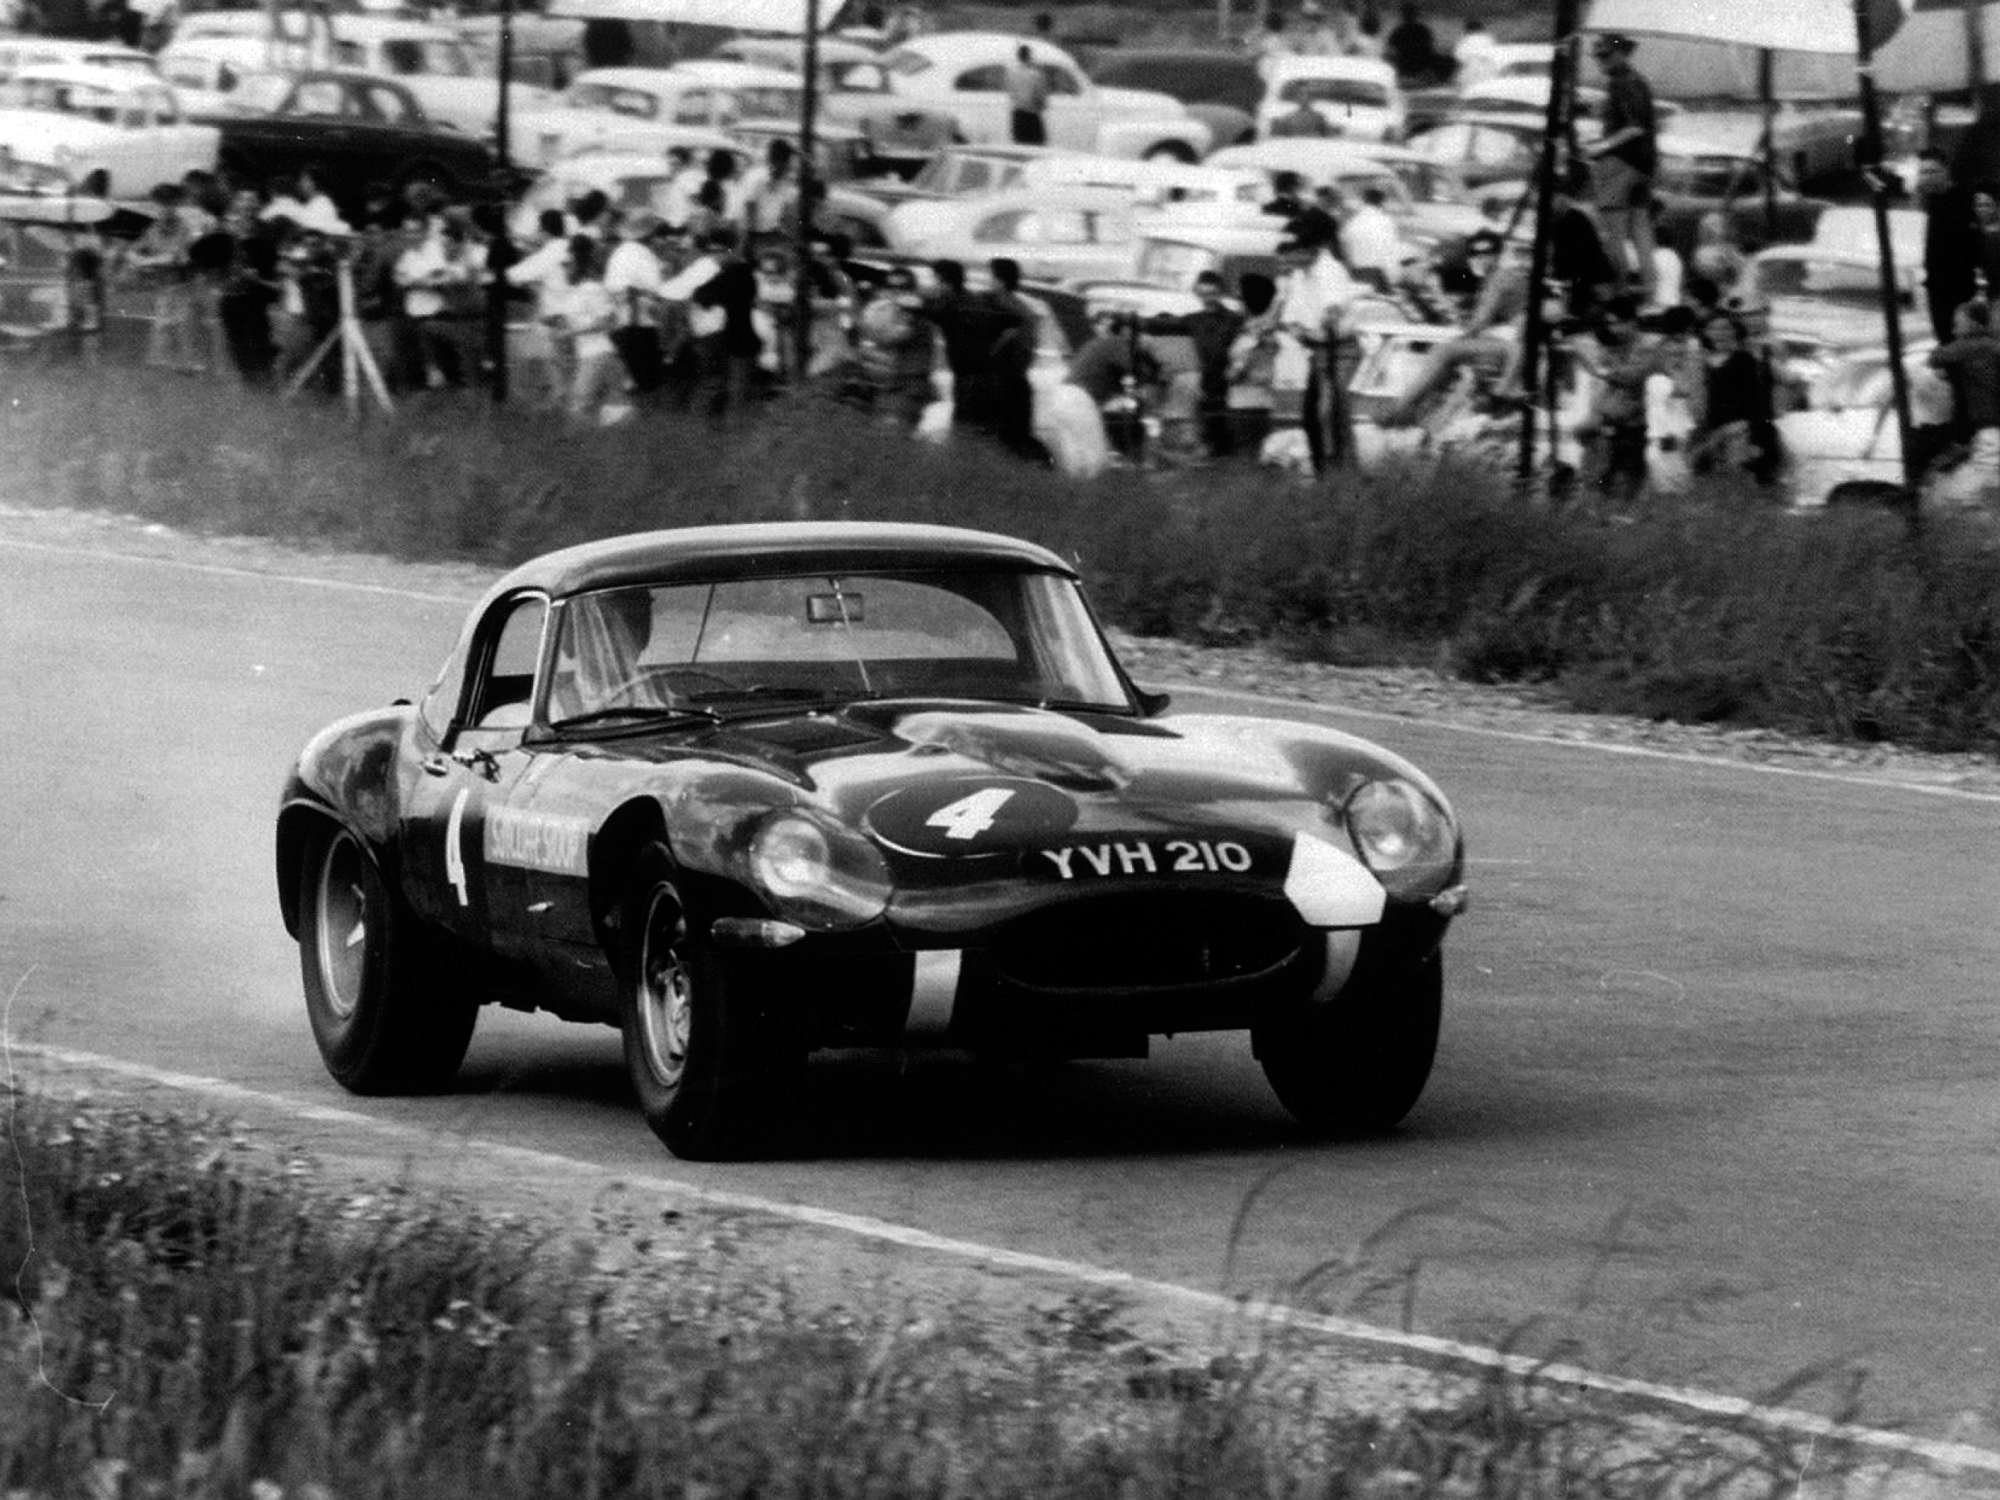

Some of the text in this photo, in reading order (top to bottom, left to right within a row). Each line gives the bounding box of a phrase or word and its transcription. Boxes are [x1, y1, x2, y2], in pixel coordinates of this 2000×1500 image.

[925, 788, 1016, 839] 4
[1041, 841, 1252, 879] YVH 210
